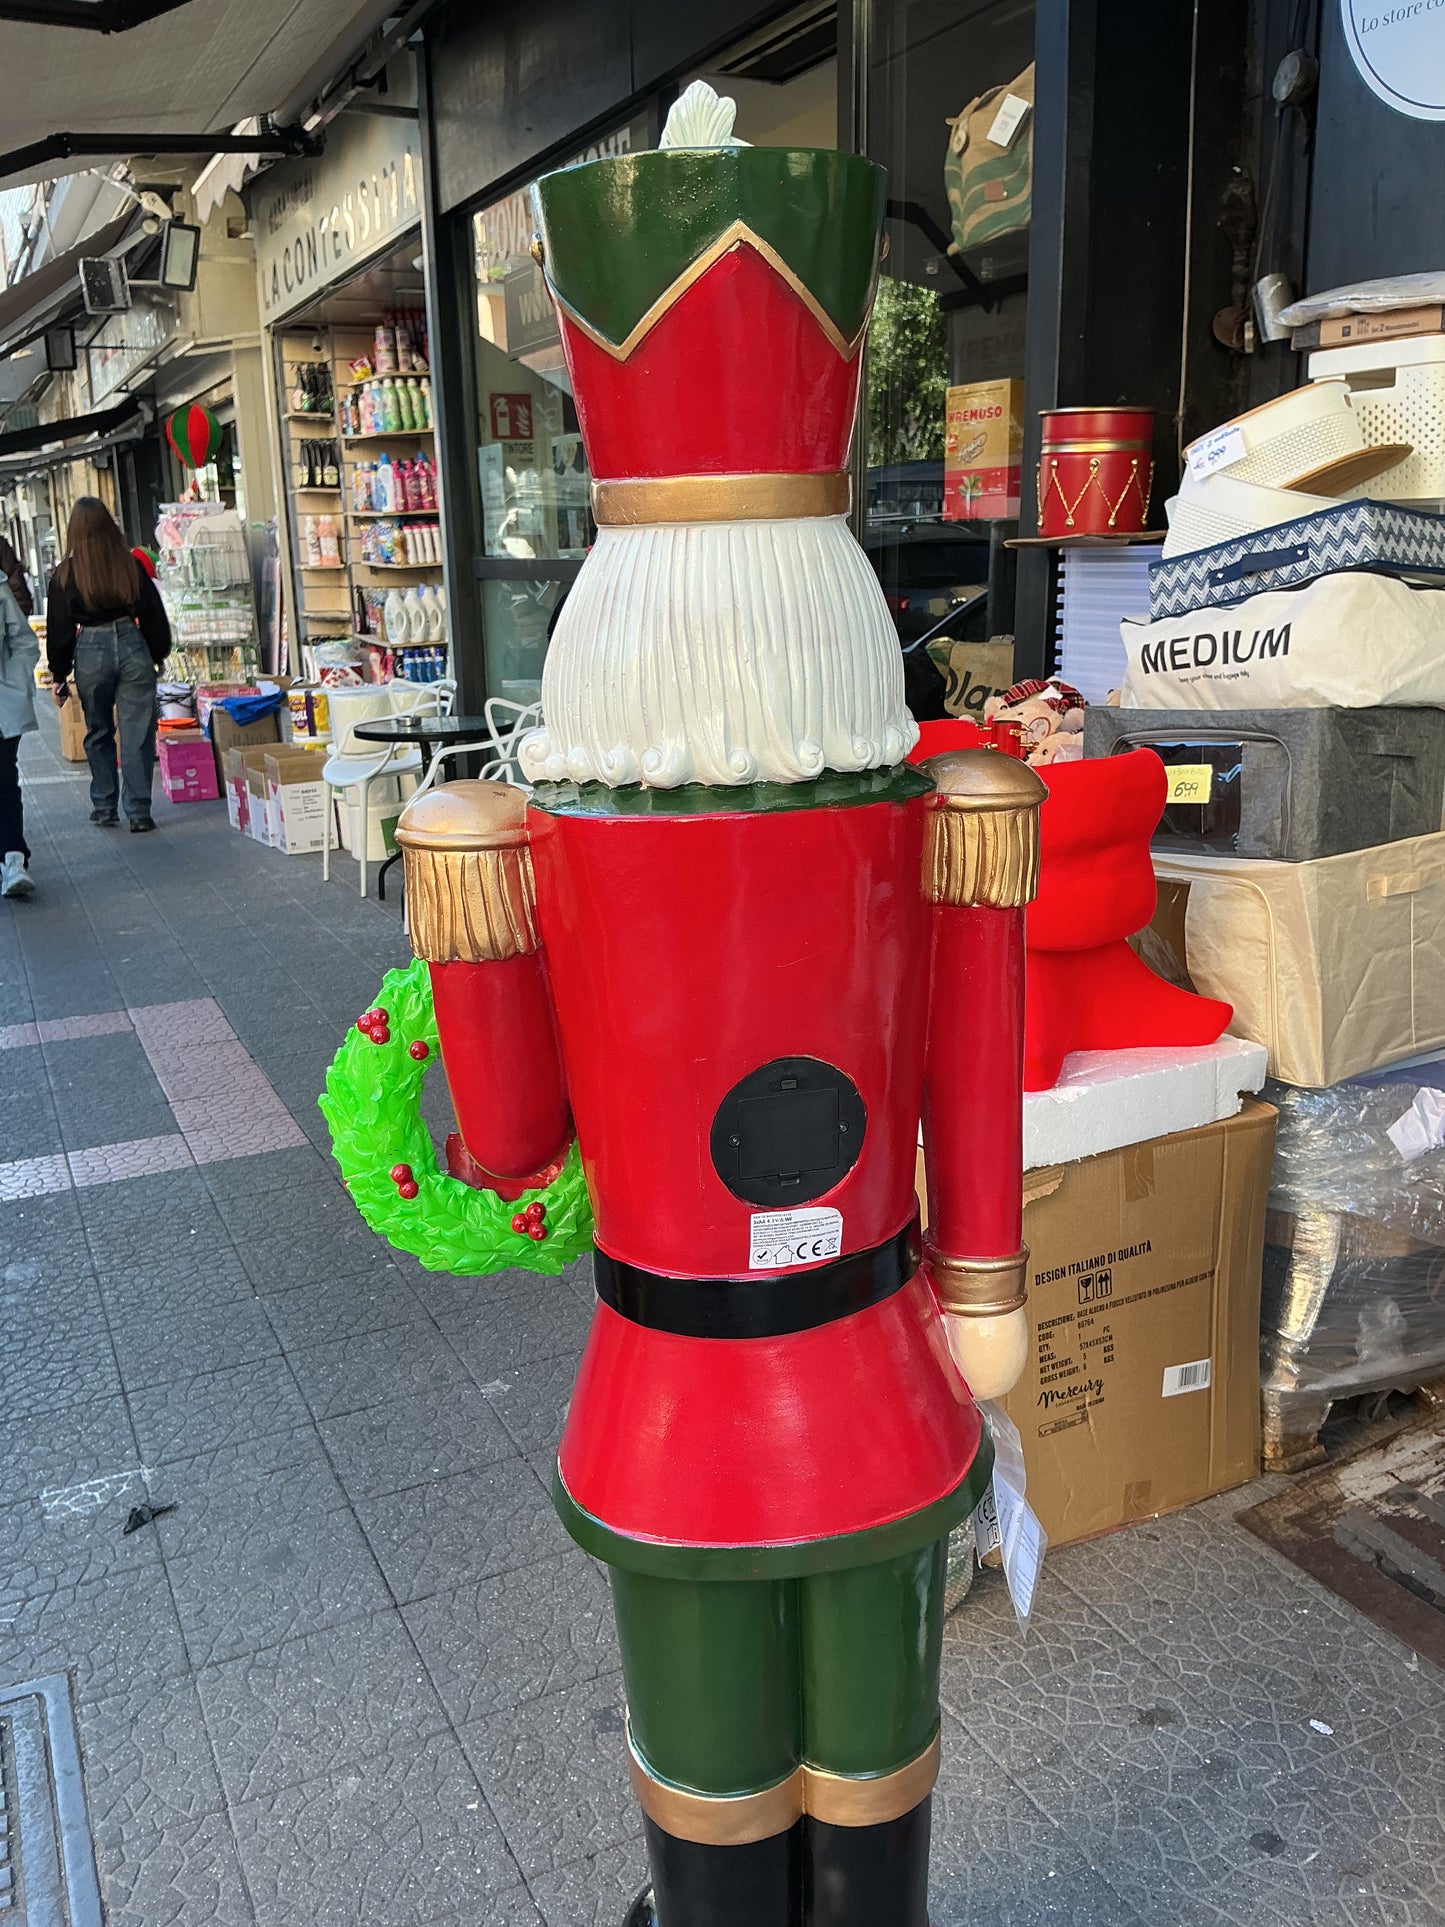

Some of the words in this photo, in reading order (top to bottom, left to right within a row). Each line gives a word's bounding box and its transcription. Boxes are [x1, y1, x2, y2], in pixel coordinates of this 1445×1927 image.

[1361, 17, 1379, 33] Lo
[1382, 2, 1422, 26] store
[1141, 622, 1292, 674] MEDIUM
[1035, 1266, 1066, 1286] DESIGN
[1068, 1255, 1106, 1276] ITALIANO
[1107, 1251, 1116, 1264] DI
[1118, 1239, 1152, 1261] QUALITÀ
[1103, 1325, 1110, 1333] PC
[1040, 1364, 1050, 1374] NET
[1040, 1373, 1058, 1385] GROSS
[1037, 1379, 1104, 1409] Mercury
